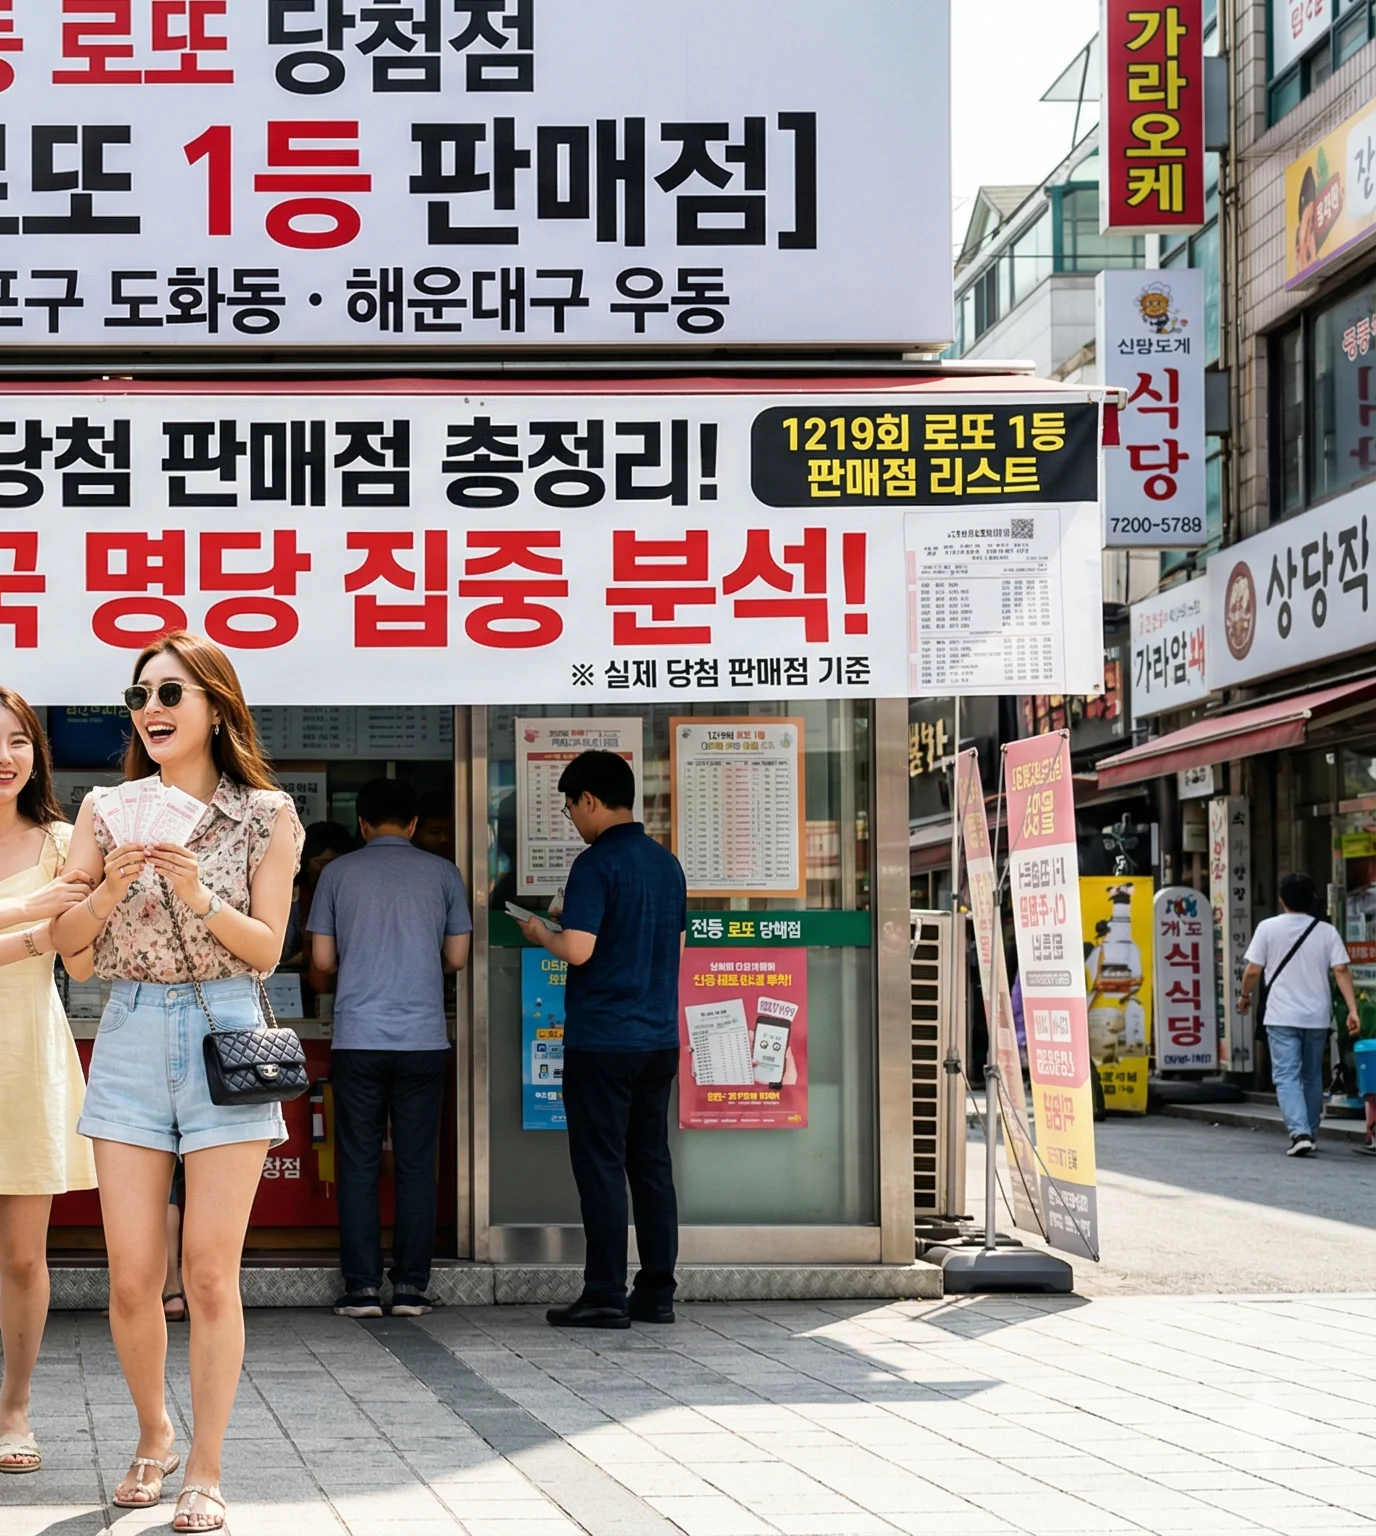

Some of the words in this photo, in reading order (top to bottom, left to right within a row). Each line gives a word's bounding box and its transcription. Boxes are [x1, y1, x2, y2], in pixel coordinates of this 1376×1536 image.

[52, 0, 234, 85] 로또
[267, 0, 534, 95] 당첨점
[1126, 7, 1187, 212] 가라오케
[183, 120, 372, 250] 1등
[409, 111, 817, 250] 판매점]
[103, 267, 286, 335] 도화동
[346, 266, 590, 333] 해운대구
[610, 267, 730, 335] 우동
[161, 419, 410, 508] 판매점
[441, 416, 718, 509] 총정리!
[783, 414, 910, 452] 1219회
[923, 414, 996, 451] 로또
[1010, 412, 1066, 452] 1등
[807, 457, 916, 498] 판매점
[930, 456, 1040, 496] 리스트
[1127, 368, 1190, 501] 식당
[85, 529, 312, 651] 명당
[344, 529, 569, 649] 집중
[605, 527, 869, 646] 분석!
[604, 659, 657, 689] 실제
[666, 658, 719, 688] 당첨
[728, 657, 808, 687] 판매점
[818, 656, 871, 685] 기준
[728, 921, 755, 938] 로또
